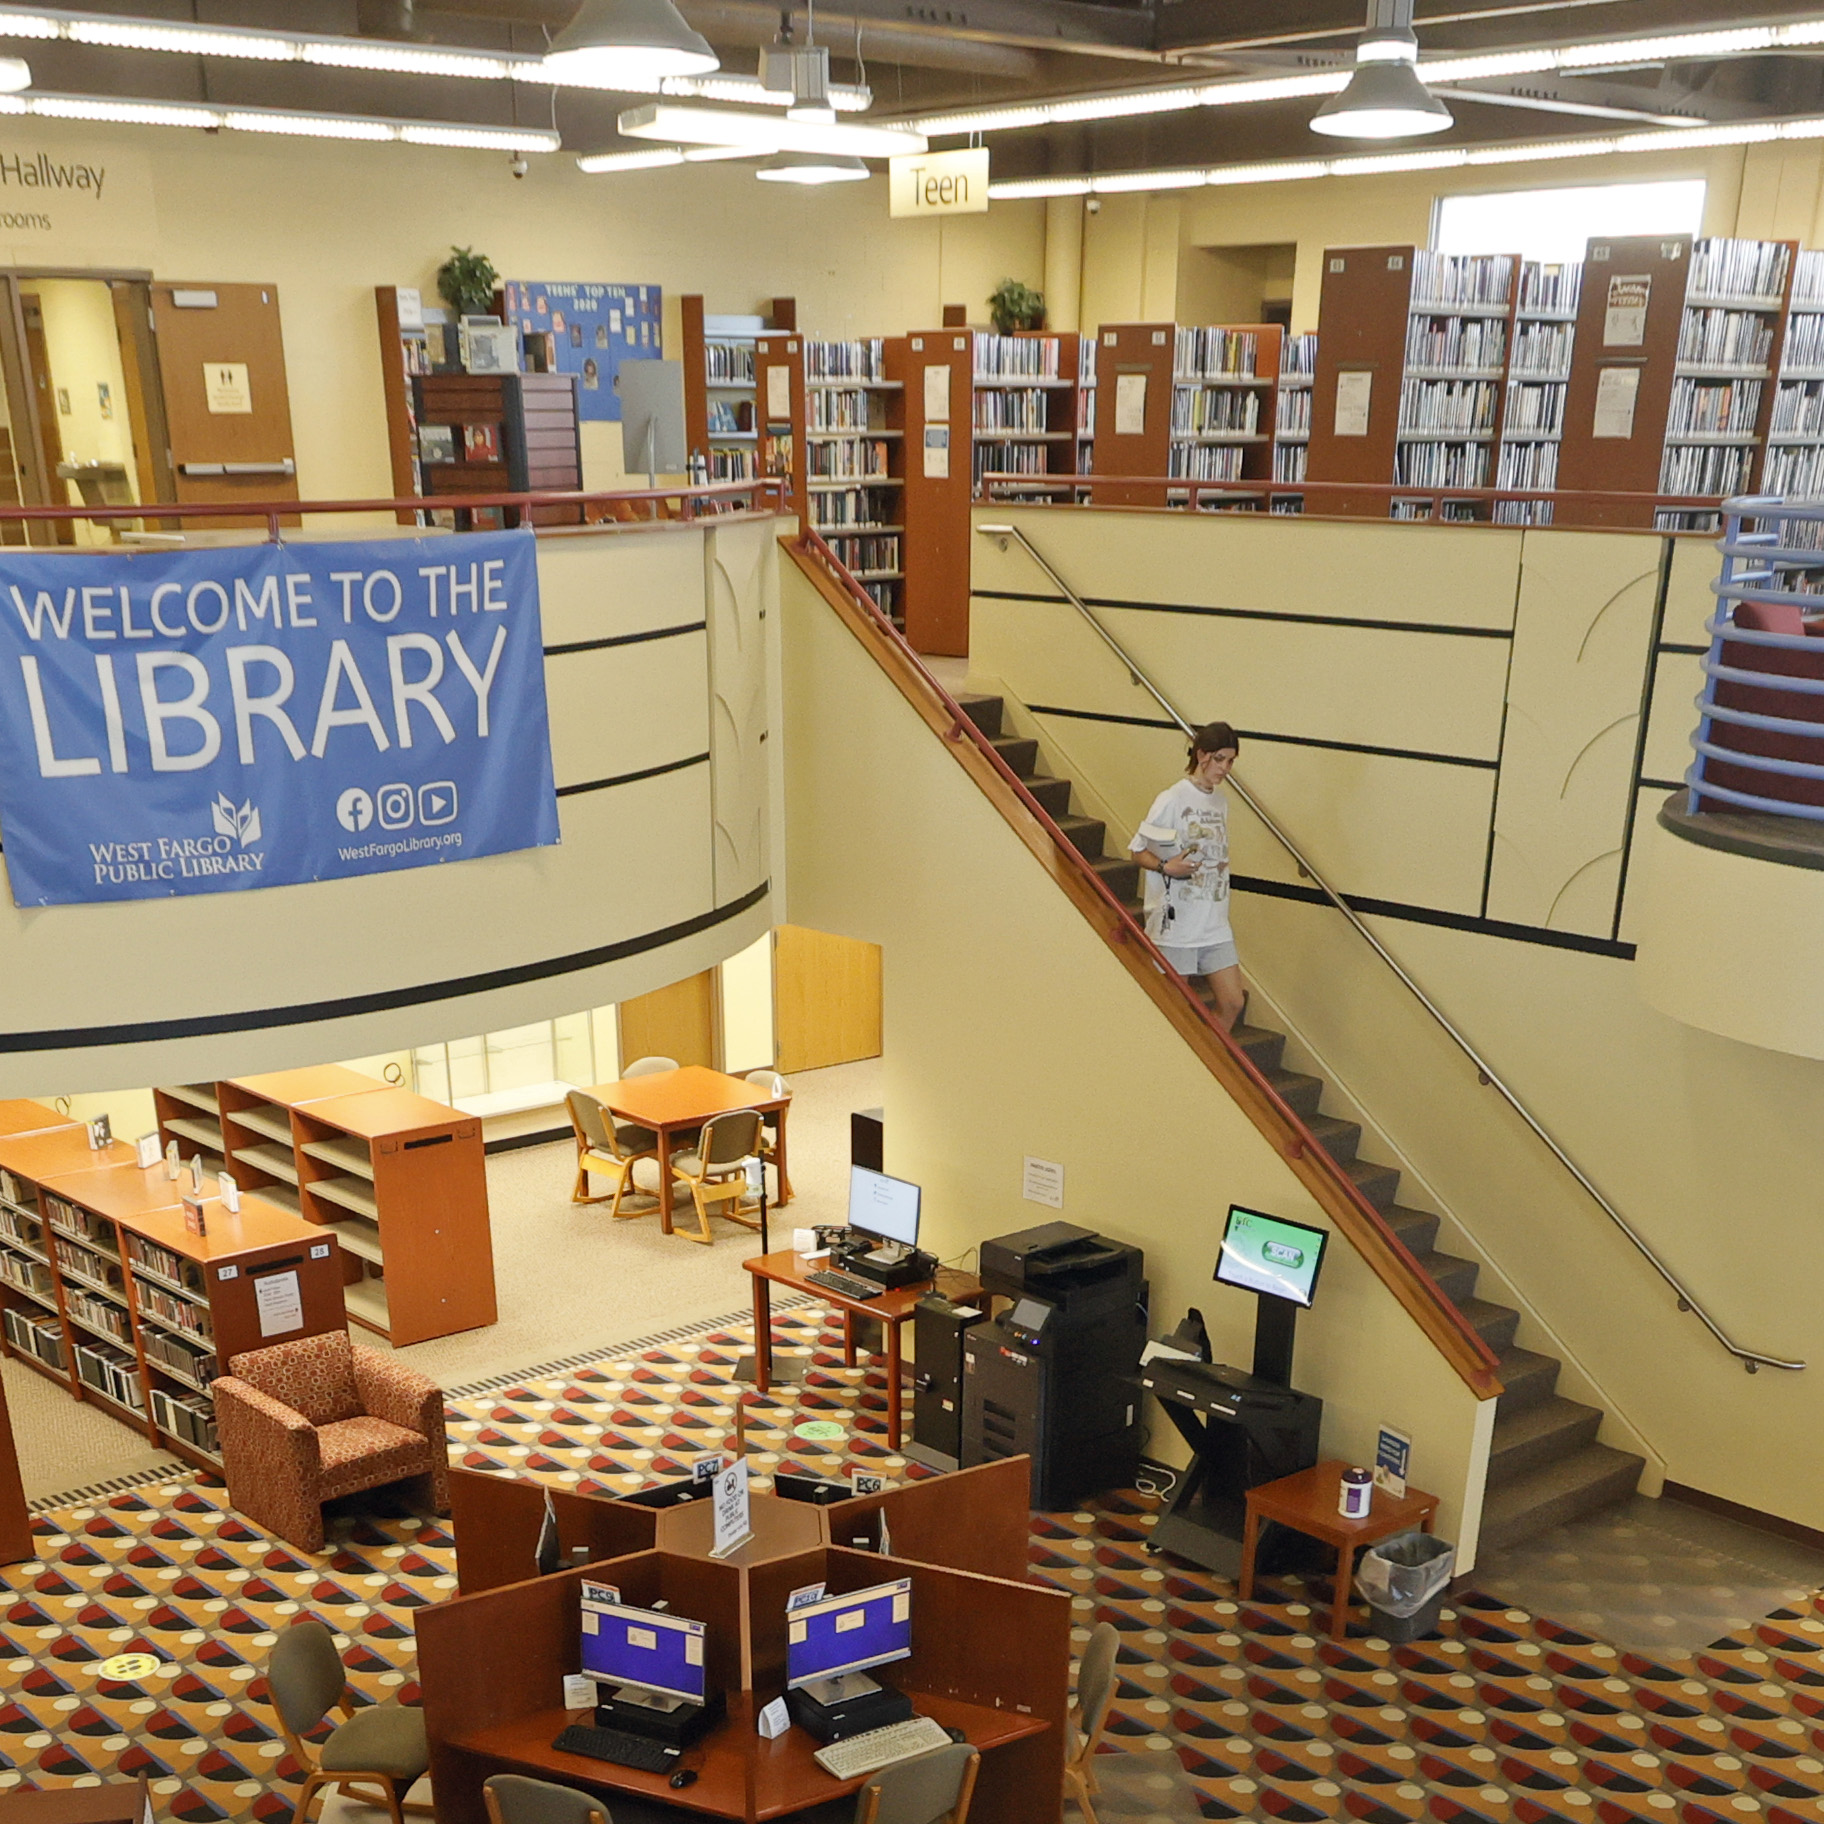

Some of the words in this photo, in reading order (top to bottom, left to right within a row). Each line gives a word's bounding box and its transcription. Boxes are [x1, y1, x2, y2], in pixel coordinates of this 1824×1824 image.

[0, 152, 105, 200] Hallway
[910, 167, 968, 206] Teen
[9, 571, 317, 641] WELCOME
[330, 568, 402, 623] TO
[418, 559, 508, 621] THE
[19, 624, 508, 777] LIBRARY
[89, 841, 153, 864] WEST
[159, 834, 232, 859] FARGO
[338, 831, 463, 862] WestFargoLibrary.org
[92, 858, 174, 885] PUBLIC
[179, 850, 265, 879] LIBRARY
[1271, 1247, 1296, 1261] SCAN
[222, 1268, 233, 1277] 27
[697, 1459, 719, 1476] PC7
[857, 1477, 881, 1492] PC6
